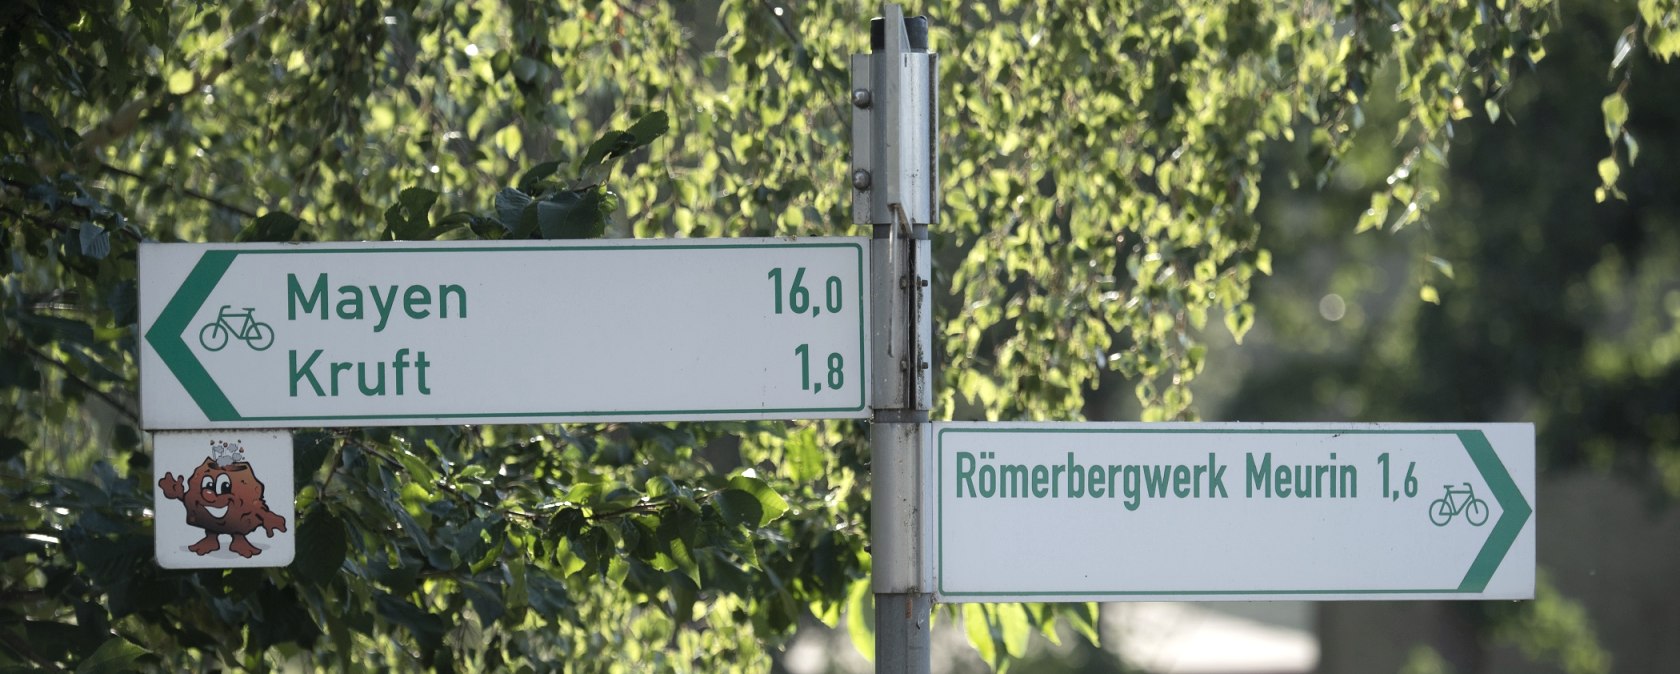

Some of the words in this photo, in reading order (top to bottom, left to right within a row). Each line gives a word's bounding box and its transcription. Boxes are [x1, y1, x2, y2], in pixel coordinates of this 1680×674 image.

[287, 272, 468, 333] Mayen
[767, 267, 843, 318] 16,0
[288, 348, 431, 398] Kruft
[794, 343, 845, 395] 1,8
[955, 451, 1229, 511] Römerbergwerk
[1245, 452, 1358, 499] Meurin
[1377, 452, 1419, 502] 1,6
